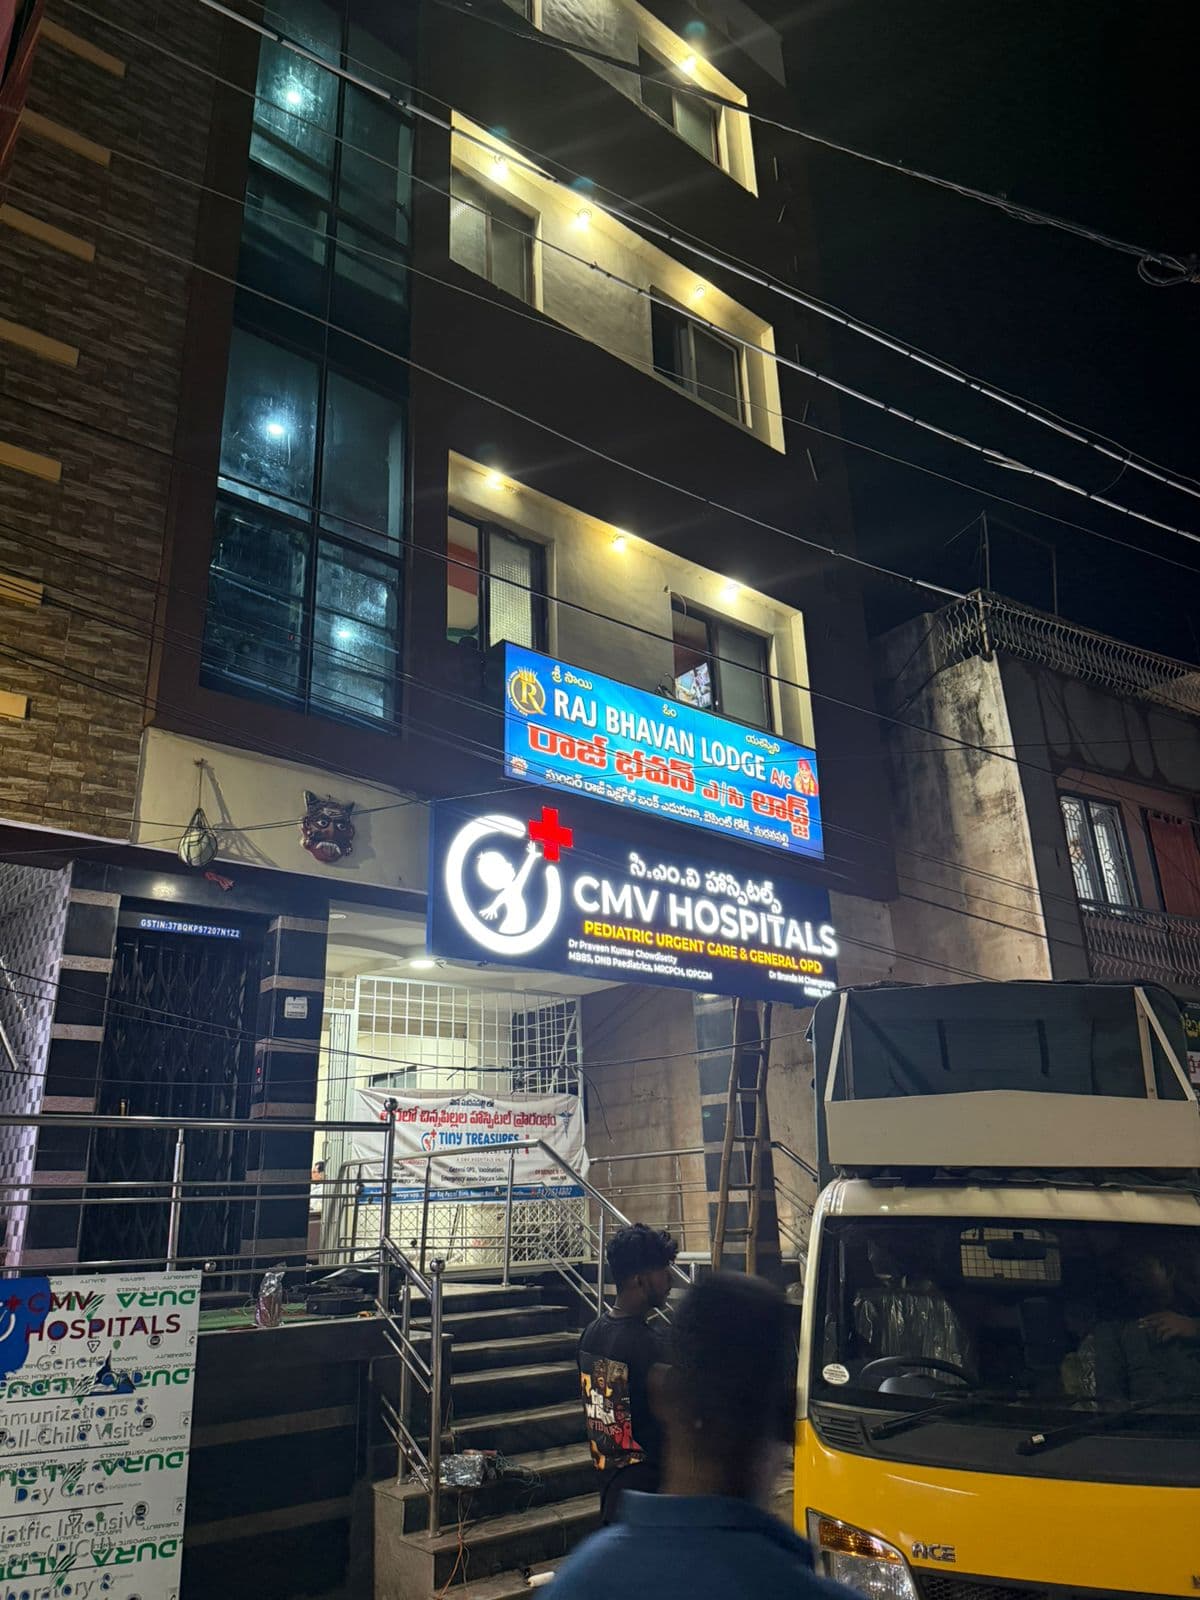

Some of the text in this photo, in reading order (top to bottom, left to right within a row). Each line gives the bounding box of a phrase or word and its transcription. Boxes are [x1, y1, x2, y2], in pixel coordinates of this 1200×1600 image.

[662, 703, 677, 718] ఓం
[554, 688, 597, 728] RAJ
[605, 704, 695, 759] BHAVAN
[701, 736, 767, 782] LODGE
[527, 722, 608, 769] రాజ్
[615, 749, 695, 795] భవన్
[573, 875, 839, 957] CMV HOSPITALS
[568, 938, 578, 949] Dr
[579, 939, 609, 953] Praveen
[610, 943, 634, 957] Kumar
[568, 951, 593, 964] MBBS,
[583, 920, 824, 974] PEDIATRIC URGENT CARE & GENERAL OPD
[28, 1291, 94, 1313] CMV
[25, 1314, 181, 1343] HOSPITALS
[15, 1486, 54, 1506] Day
[61, 1481, 105, 1498] Care
[911, 1541, 957, 1563] ACE
